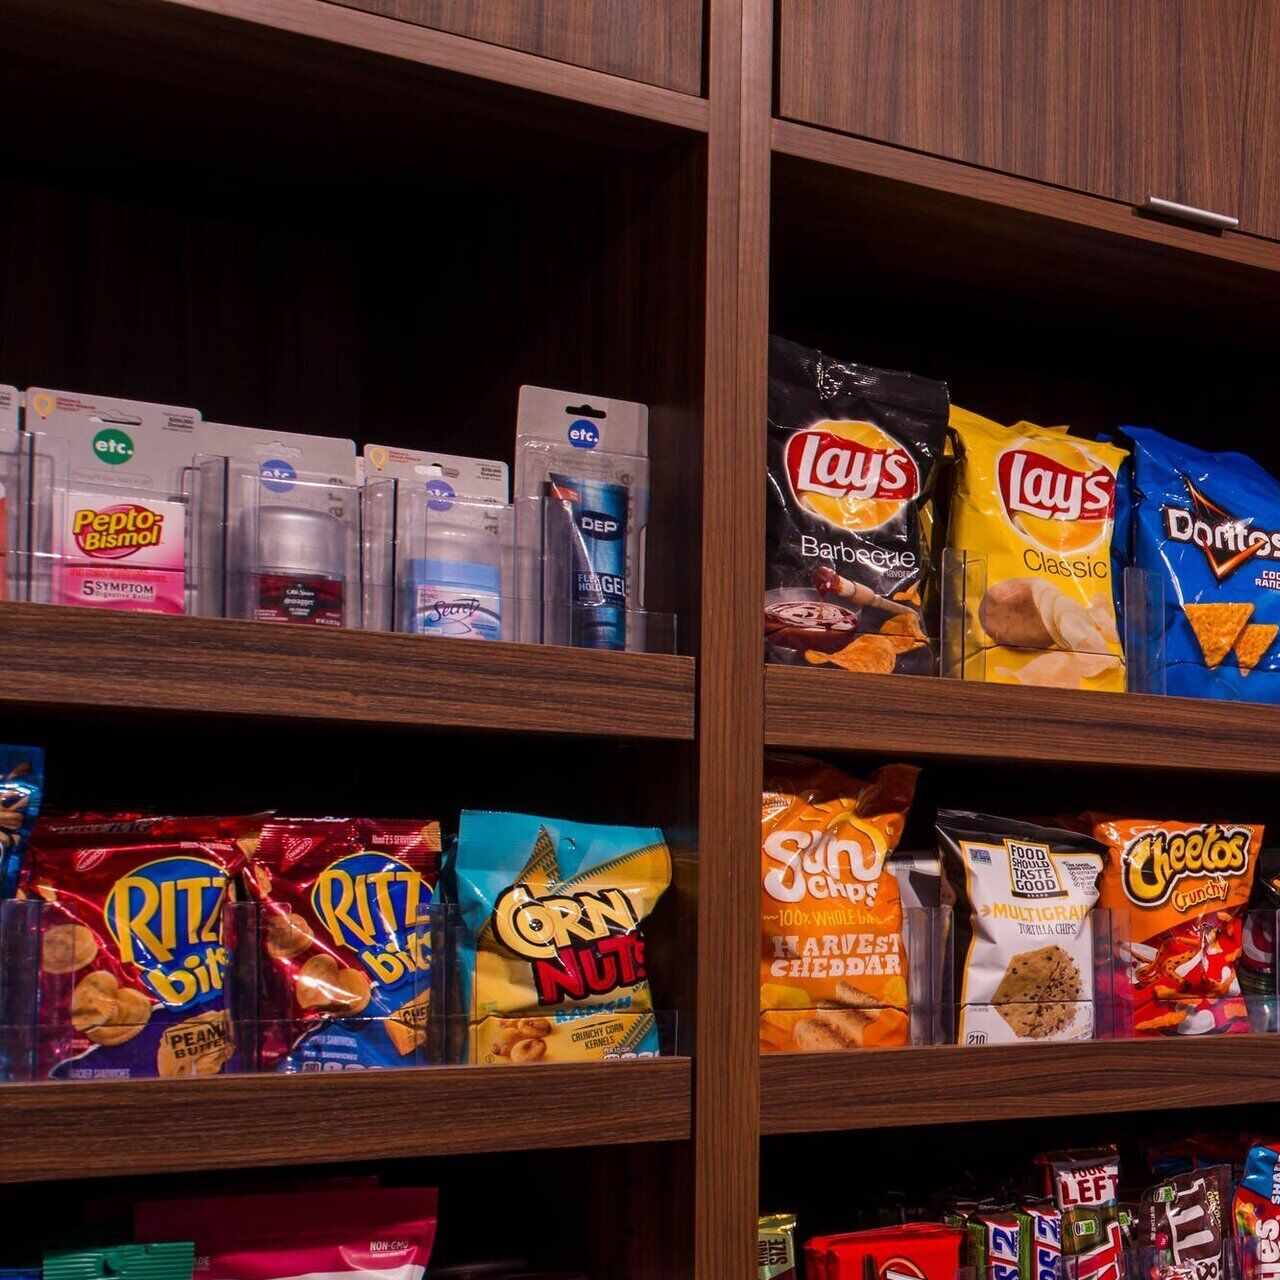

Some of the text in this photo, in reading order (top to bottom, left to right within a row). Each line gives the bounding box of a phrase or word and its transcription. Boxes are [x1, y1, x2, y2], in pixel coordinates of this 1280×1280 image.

[95, 439, 134, 456] etc.
[570, 428, 599, 444] etc.
[797, 435, 909, 500] Lay's
[1009, 453, 1111, 521] Lay's
[73, 506, 163, 534] Pepto-
[582, 517, 617, 532] DEP
[84, 526, 161, 551] Bismol
[801, 535, 916, 568] Barbecue
[1023, 549, 1108, 580] Classic
[83, 581, 154, 596] 5 SYMPTOM
[430, 597, 480, 622] Secret
[1011, 844, 1046, 861] FOOD
[1012, 858, 1051, 869] SHOULD
[1129, 825, 1248, 900] Cheetos
[763, 830, 888, 904] Sun
[1013, 868, 1052, 881] TASTE
[1015, 879, 1056, 892] GOOD
[1172, 877, 1228, 912] Crunchy
[115, 876, 228, 964] RITZ
[321, 871, 424, 947] RITZ
[497, 889, 636, 952] CORN
[779, 909, 811, 928] 100%
[814, 909, 855, 925] WHOLE
[1055, 922, 1076, 936] CHIPS
[770, 932, 901, 959] HARVEST
[769, 954, 903, 979] CHEDDAR
[571, 1022, 625, 1042] CRUNCHY CORN
[585, 1036, 616, 1051] KERNELS
[1071, 1166, 1107, 1180] FOUR
[1060, 1174, 1119, 1205] LEFT
[770, 1238, 788, 1266] SIZE
